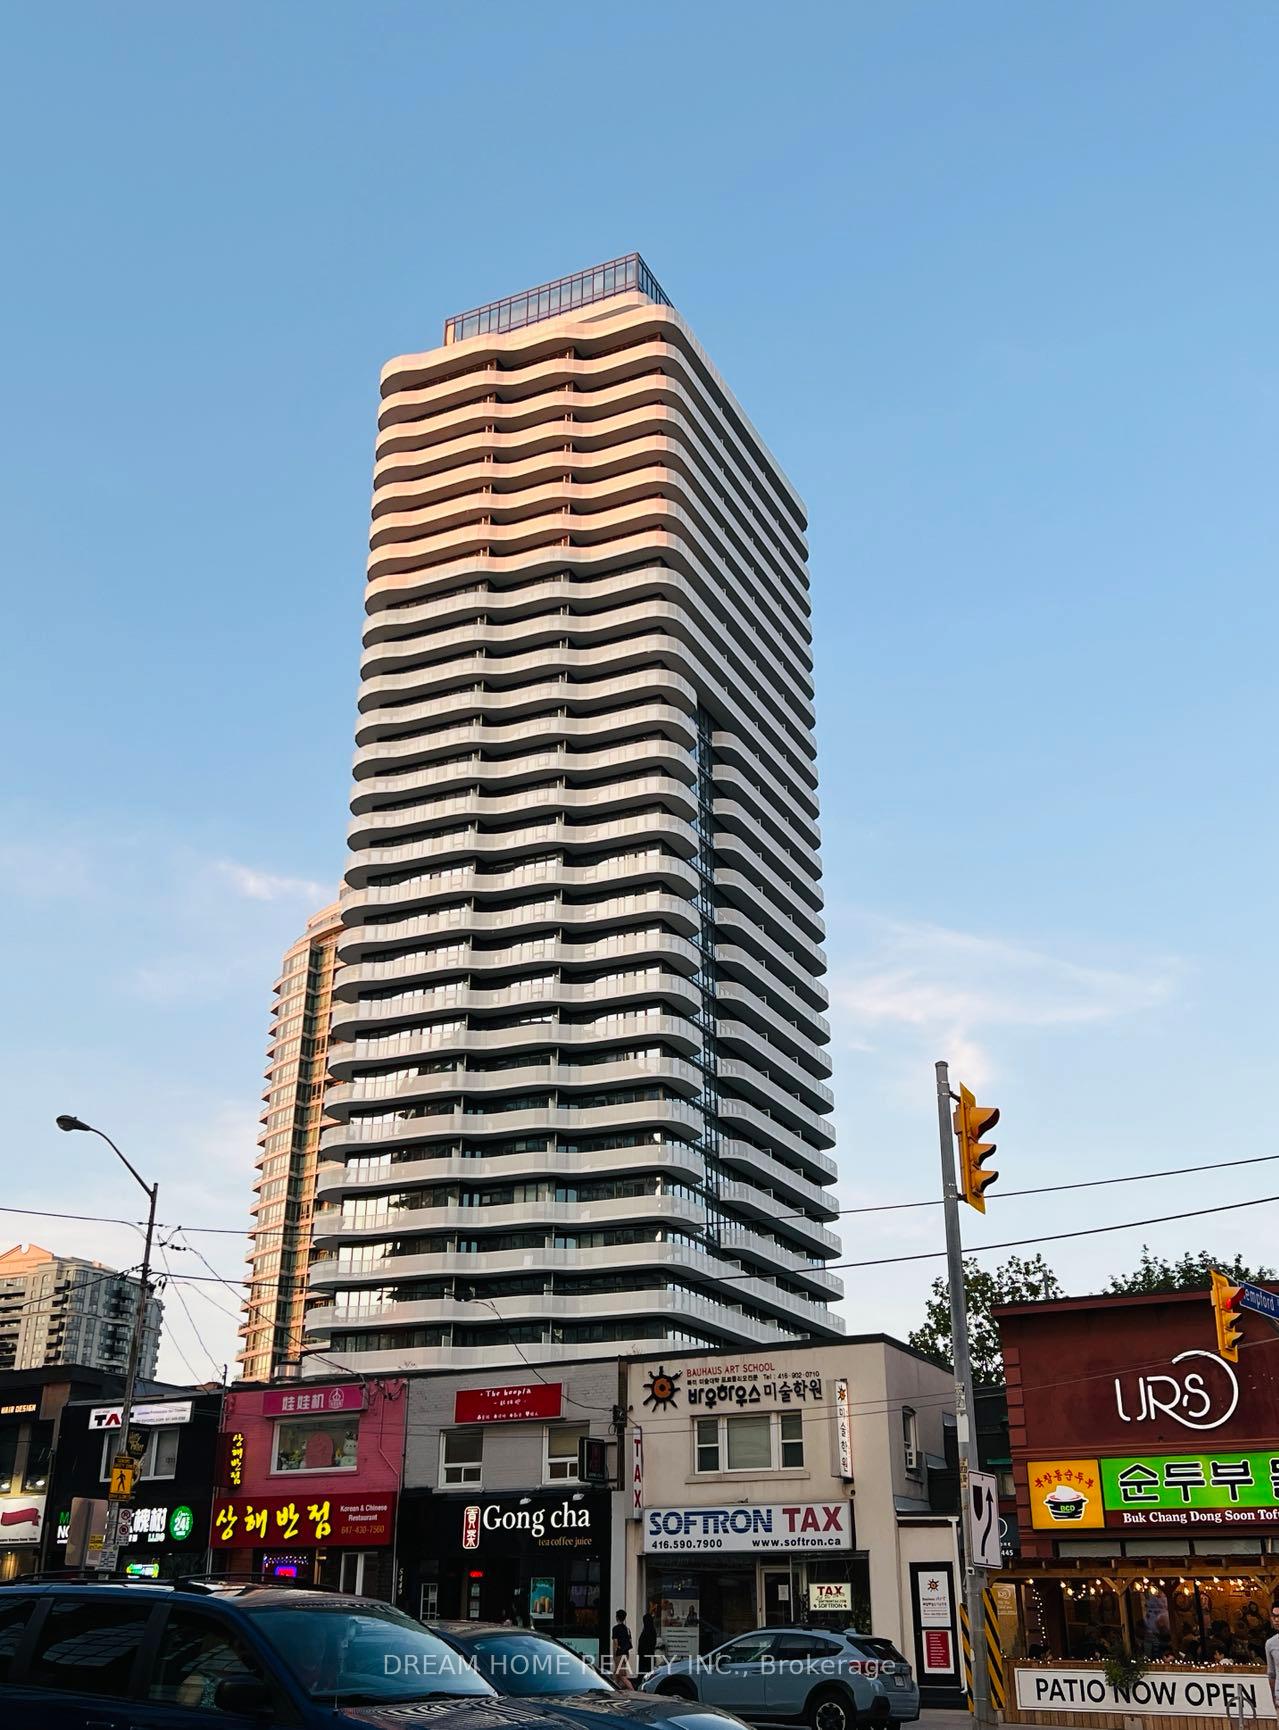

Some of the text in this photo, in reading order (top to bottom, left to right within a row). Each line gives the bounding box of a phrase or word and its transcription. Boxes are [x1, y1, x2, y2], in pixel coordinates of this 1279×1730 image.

[1243, 1288, 1275, 1311] empford
[686, 1362, 775, 1377] BAUHAUS ART SCHOOL
[281, 1393, 325, 1411] 娃娃机
[687, 1379, 823, 1409] 바우하우스 미술학원
[94, 1412, 135, 1427] TA
[230, 1433, 244, 1485] 상해반점
[634, 1438, 642, 1509] TAX
[1117, 1458, 1255, 1504] 순두부
[365, 1504, 388, 1512] Chinese
[482, 1501, 591, 1538] Gong cha
[1122, 1511, 1147, 1524] Buk
[1149, 1510, 1188, 1525] Chang
[1190, 1510, 1223, 1524] Dong
[1225, 1509, 1256, 1521] Soon
[215, 1500, 332, 1541] 상해반점
[649, 1506, 844, 1536] SOFTRON TAX
[538, 1535, 593, 1548] tea coffee juice
[652, 1536, 842, 1549] 416.590.7900 www.softron.ca
[816, 1586, 843, 1596] TAX
[1035, 1677, 1257, 1708] PATIO NOW OPEN
